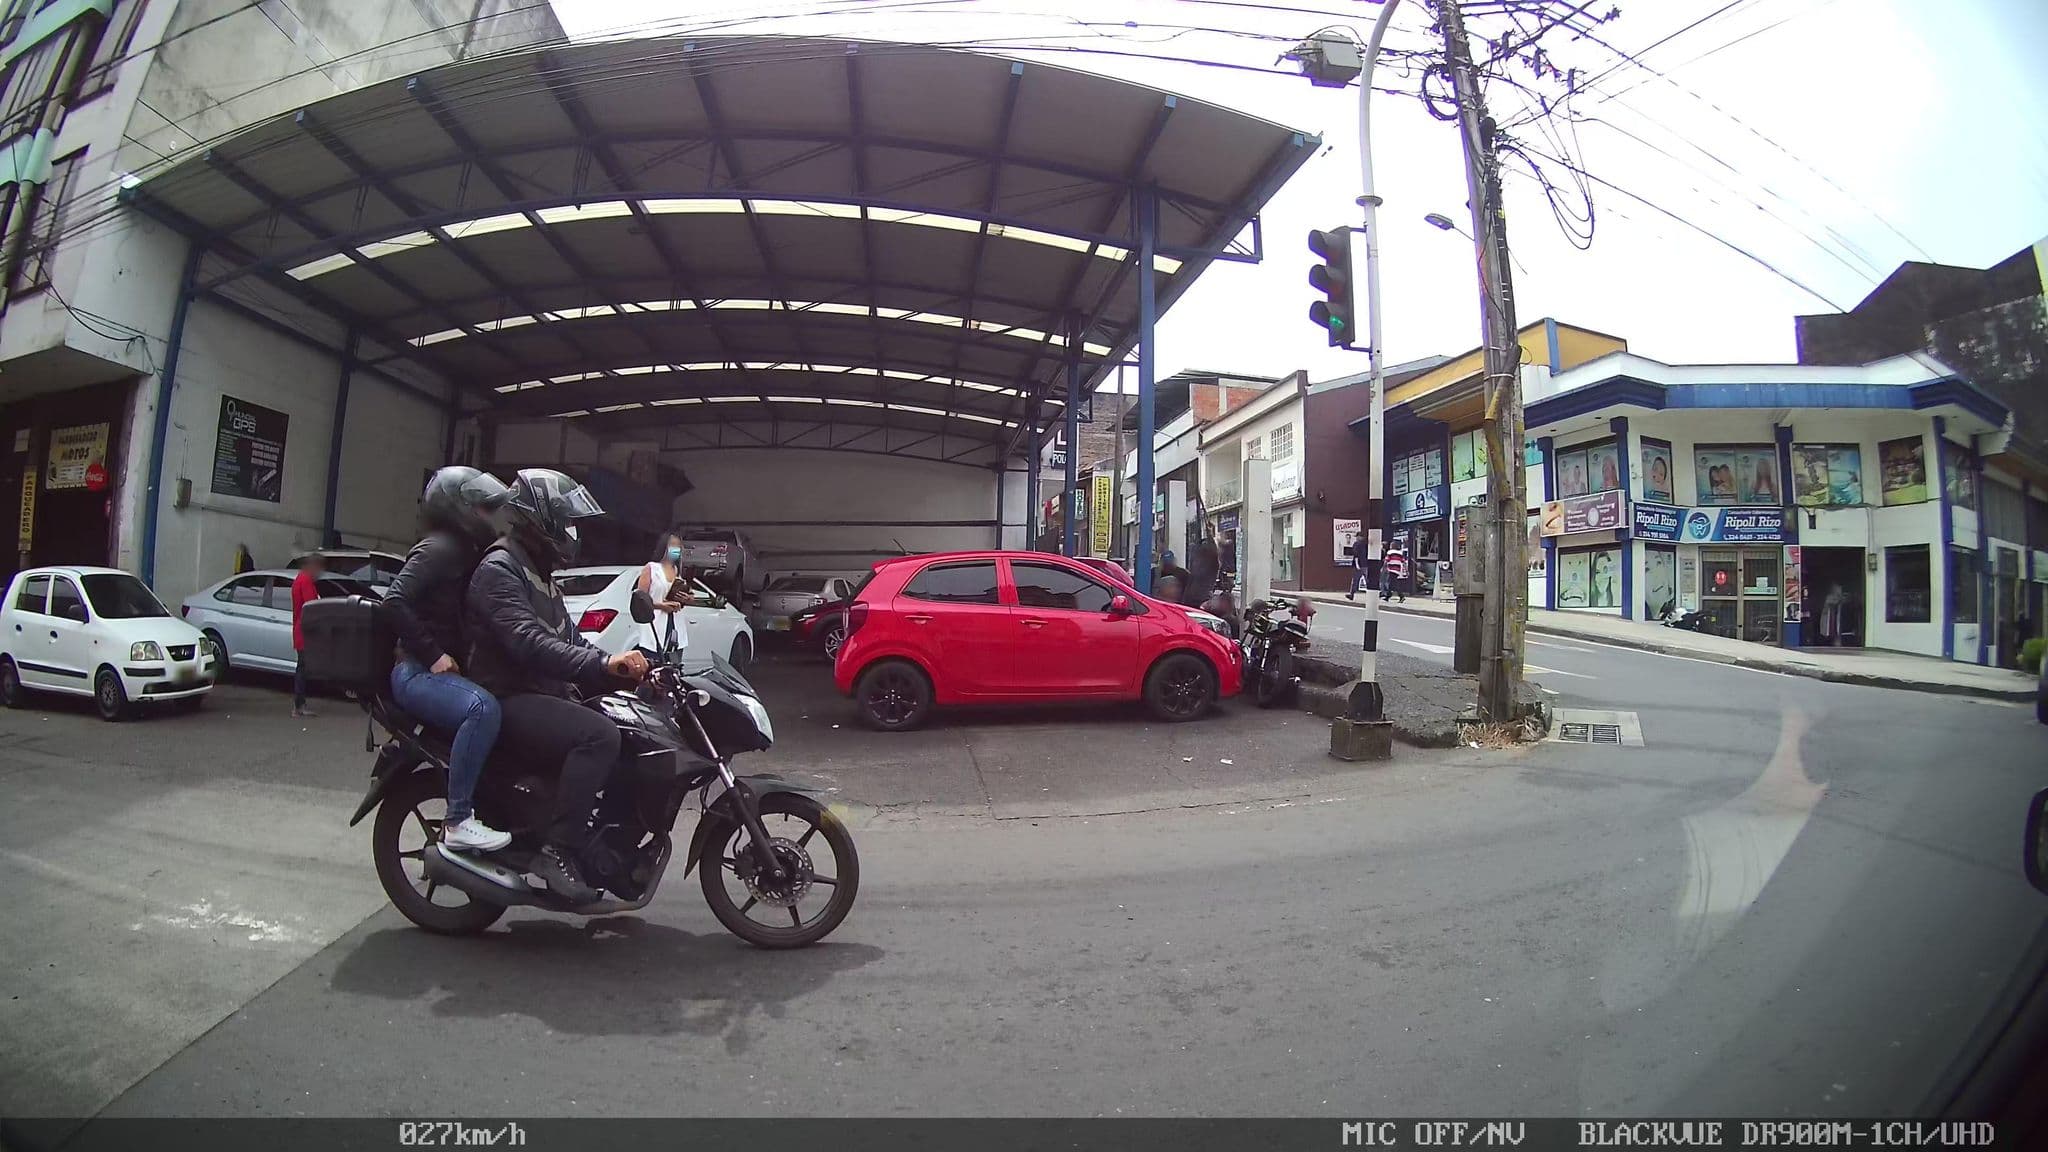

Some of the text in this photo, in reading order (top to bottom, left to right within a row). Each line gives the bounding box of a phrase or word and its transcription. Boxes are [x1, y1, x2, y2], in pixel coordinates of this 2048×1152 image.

[233, 417, 257, 433] GPS
[1335, 521, 1360, 531] USADOS
[1636, 511, 1678, 527] Ripoll Rizo
[1724, 516, 1781, 530] Ripoll Rizo
